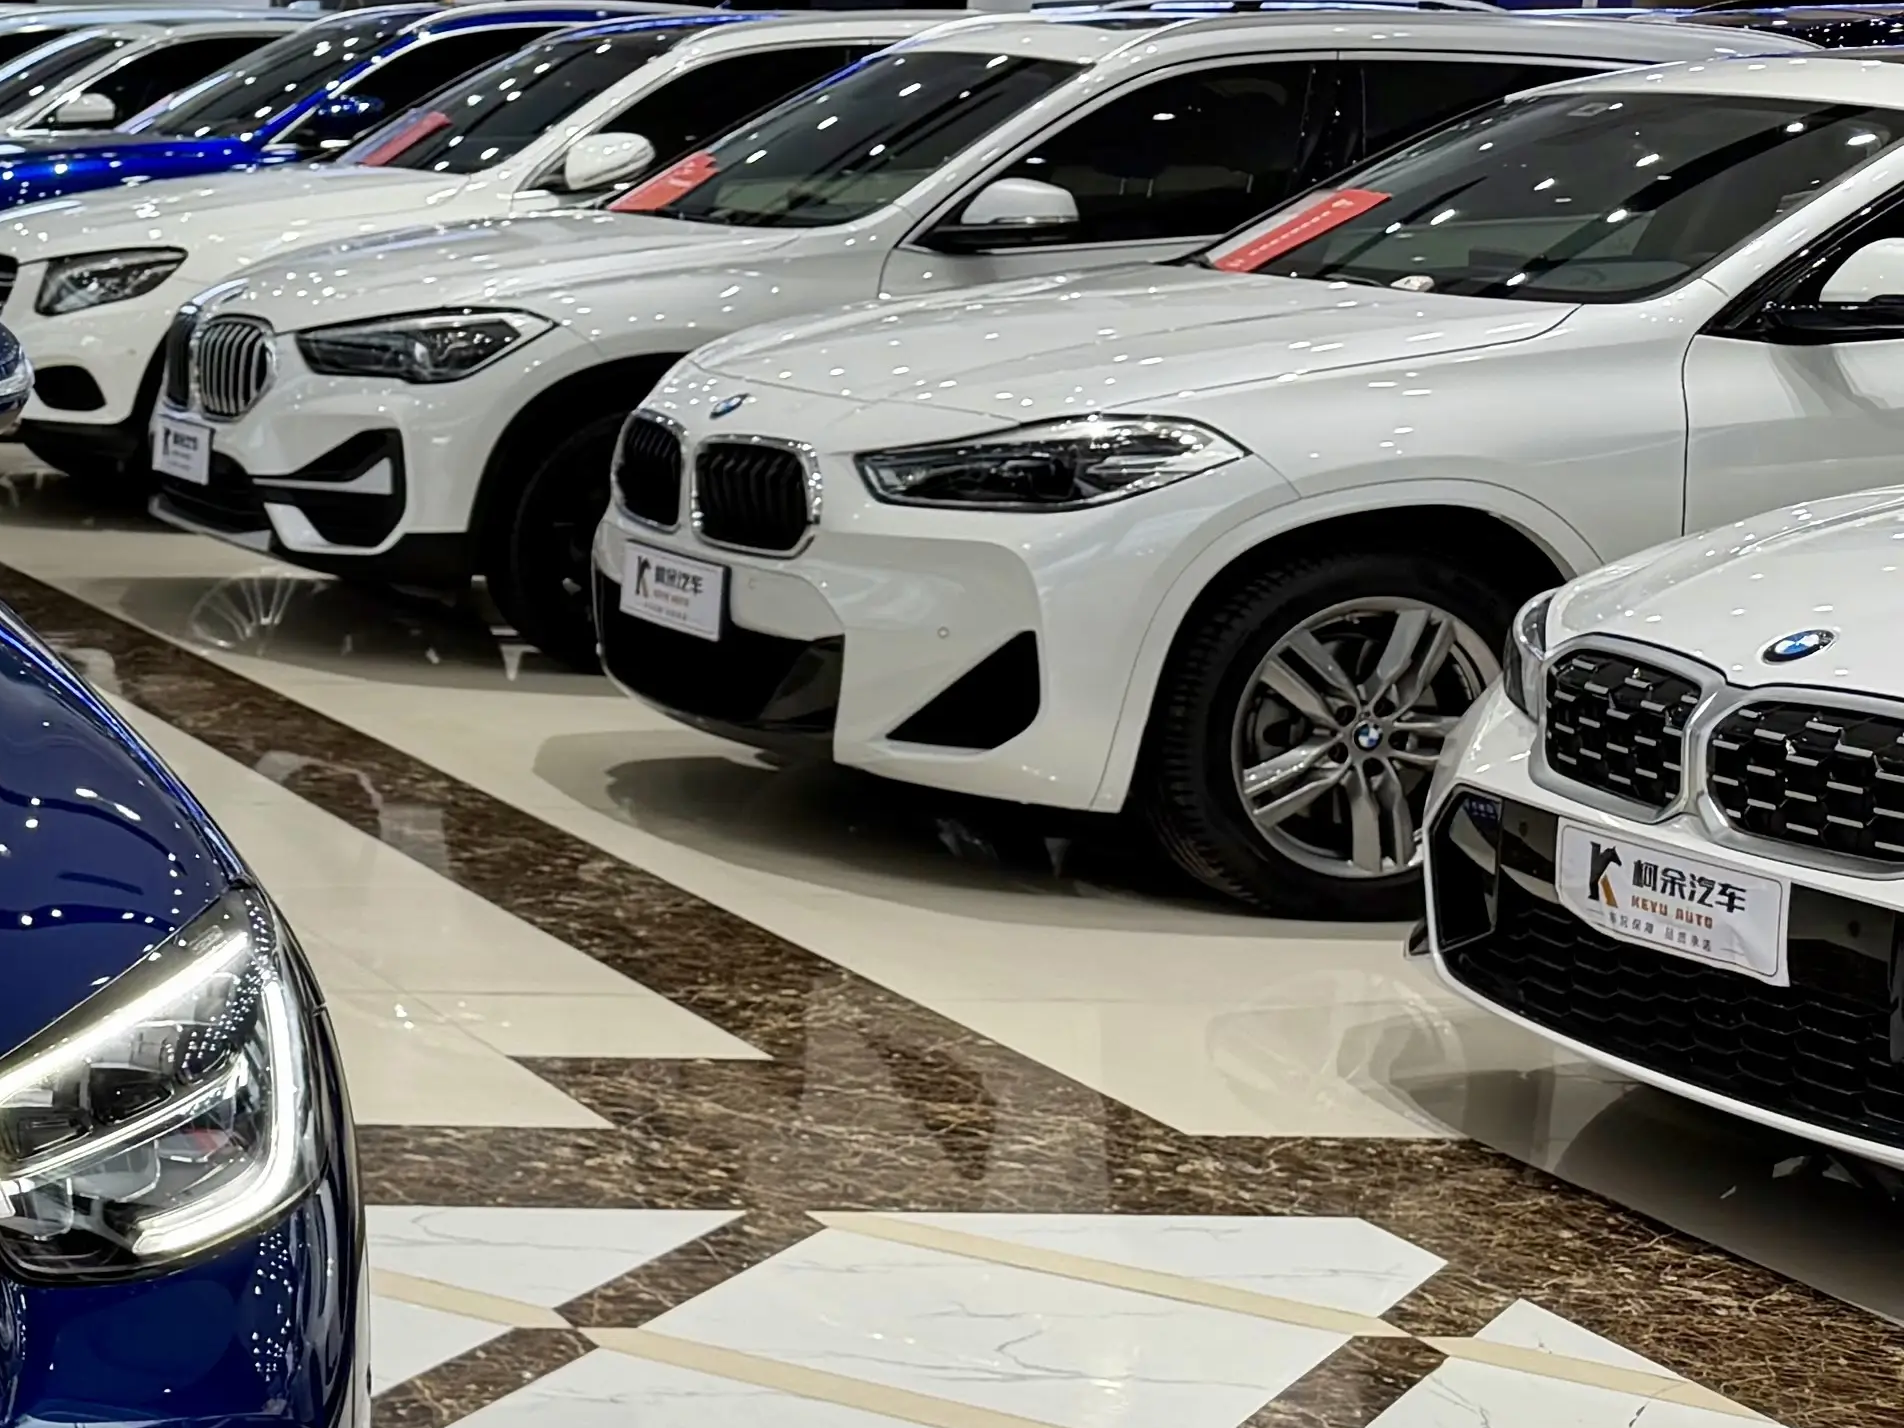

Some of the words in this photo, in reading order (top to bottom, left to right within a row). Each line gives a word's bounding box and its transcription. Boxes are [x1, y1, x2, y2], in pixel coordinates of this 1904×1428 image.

[1632, 859, 1747, 913] 柯余汽车
[1631, 895, 1668, 916] KEYU
[1675, 907, 1713, 930] AUTO
